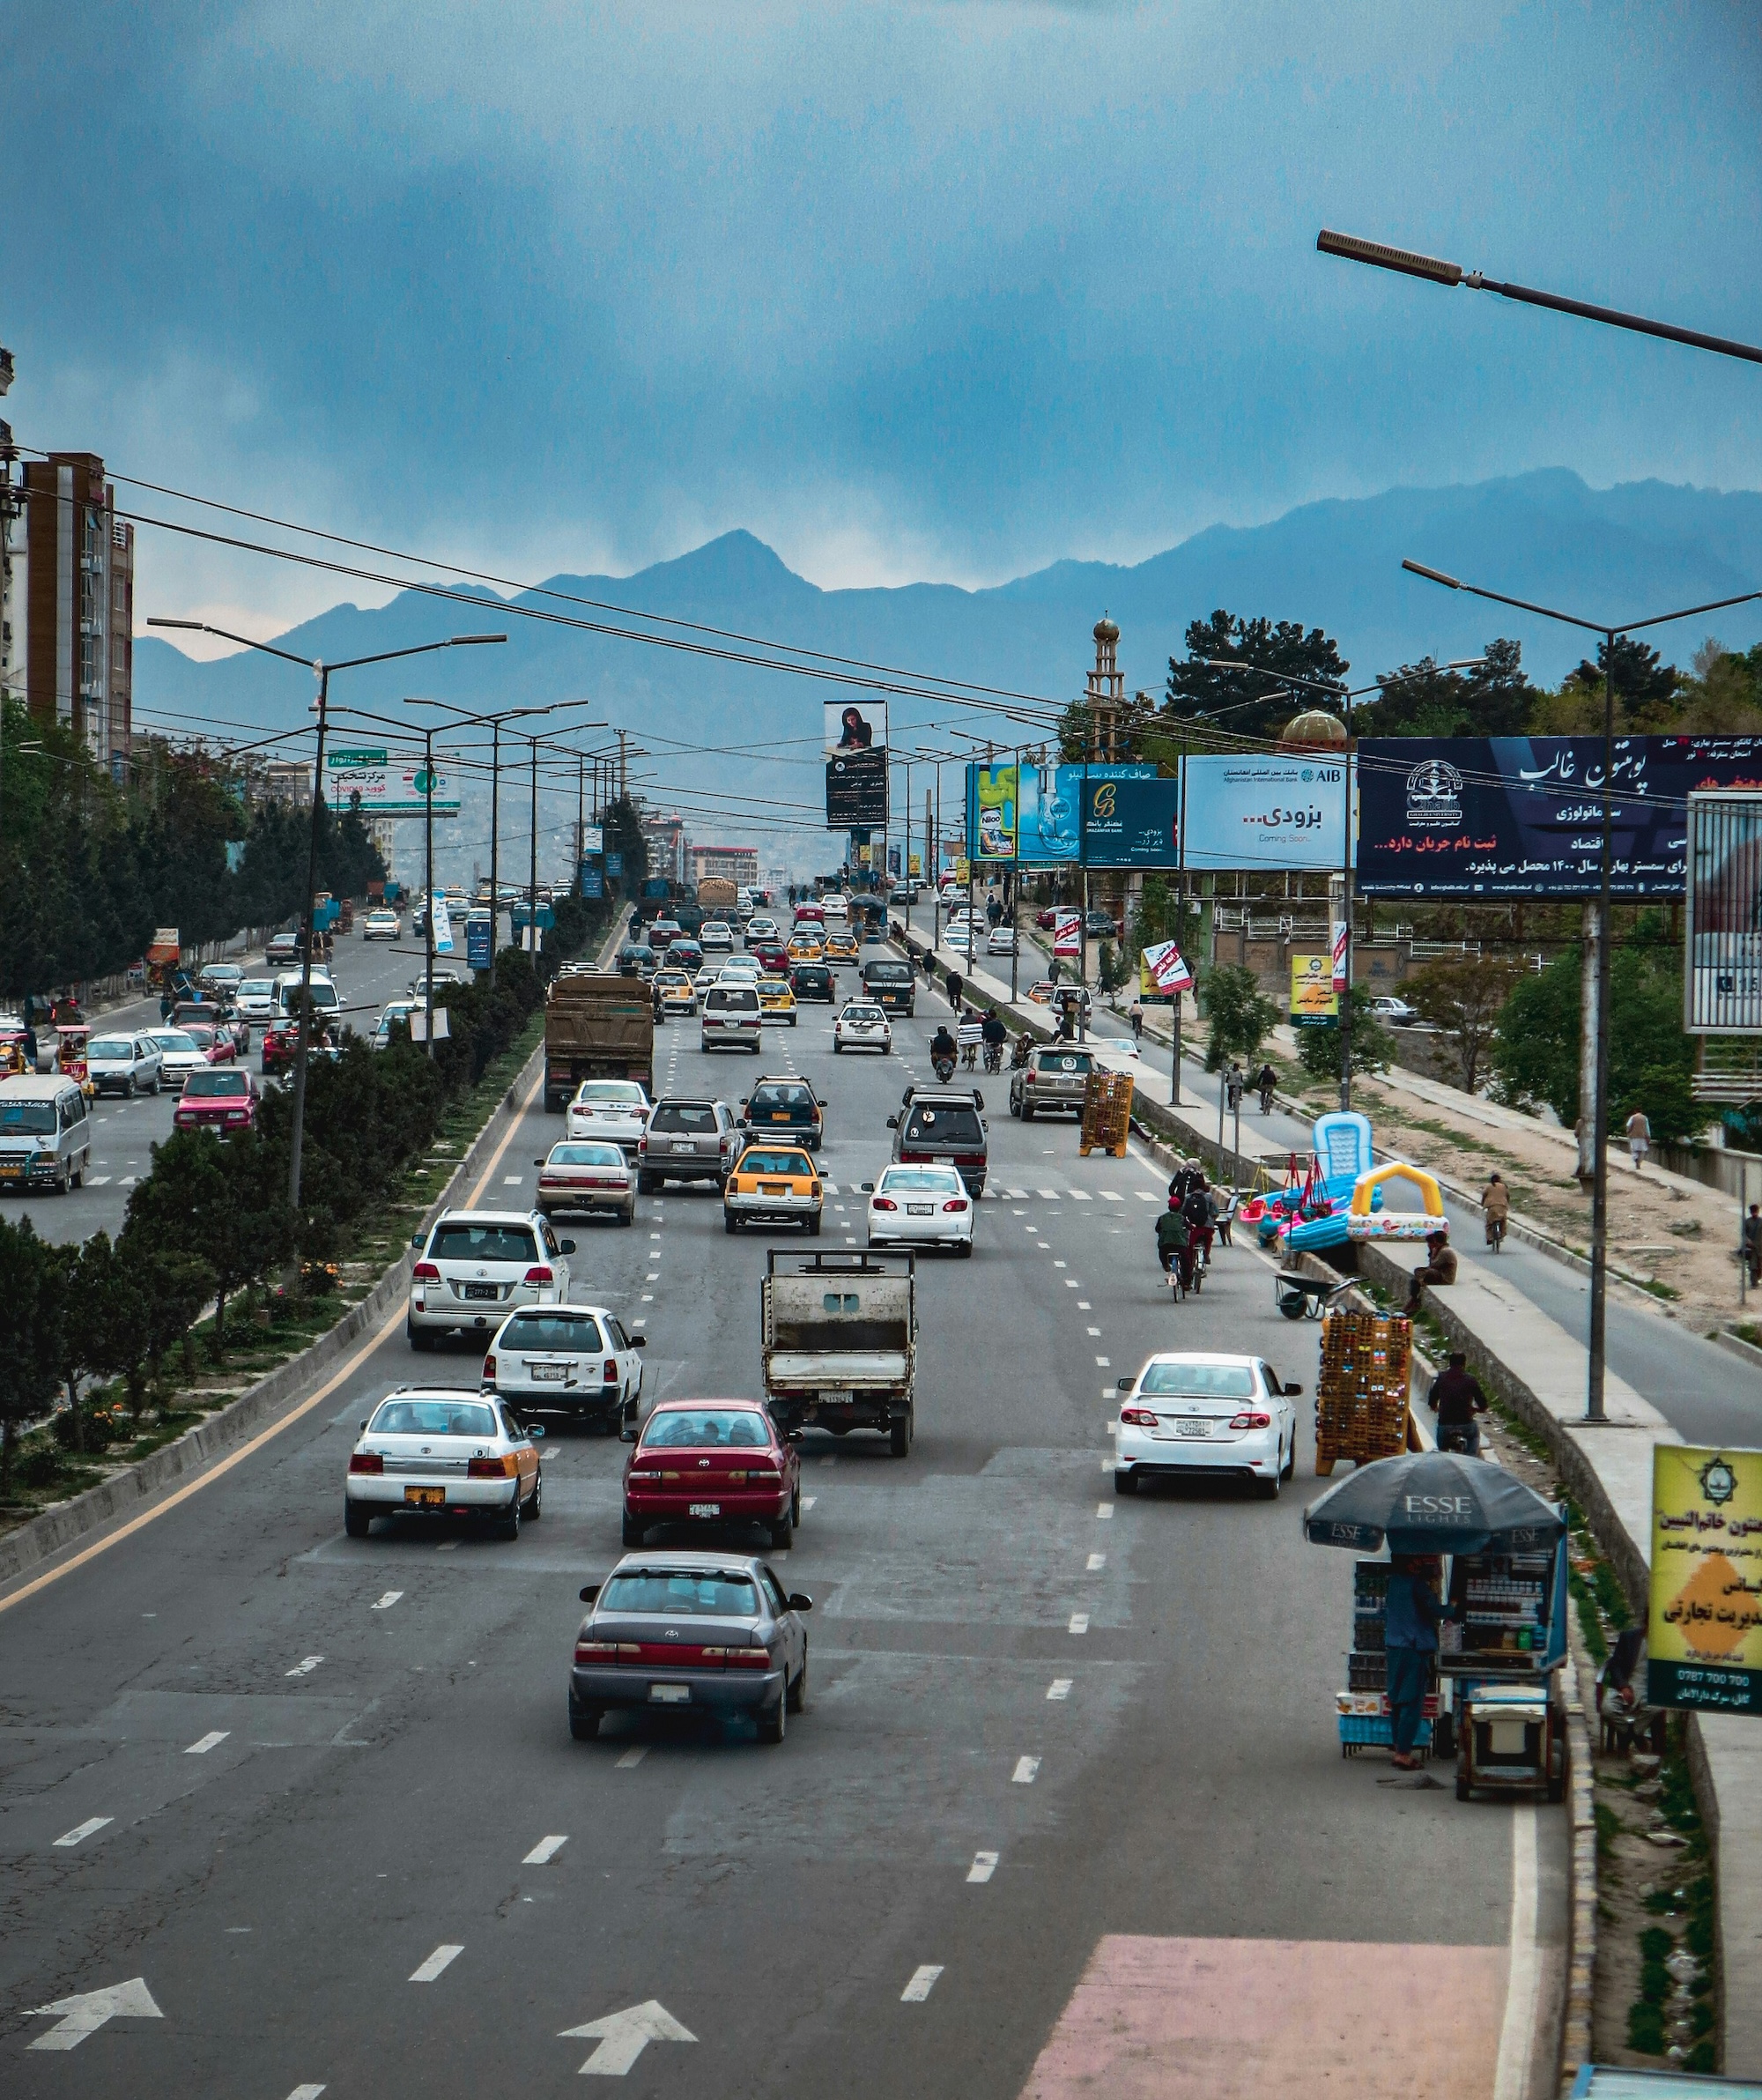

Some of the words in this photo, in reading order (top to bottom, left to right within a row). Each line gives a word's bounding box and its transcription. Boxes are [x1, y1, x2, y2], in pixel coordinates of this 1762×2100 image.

[1316, 770, 1341, 783] AIB
[1520, 750, 1576, 790] غالب
[1415, 836, 1452, 852] جریان
[1454, 835, 1471, 851] نام
[1473, 834, 1498, 851] ثبت
[1571, 836, 1604, 850] اقتصاد
[1499, 863, 1515, 874] می
[1518, 859, 1551, 874] محصل
[1577, 860, 1598, 874] سال
[1600, 859, 1630, 874] بهار
[1632, 860, 1665, 874] سمستر
[1667, 859, 1687, 874] رای
[1405, 1495, 1473, 1514] ESSE
[1408, 1514, 1471, 1525] LIGHTS
[1331, 1523, 1362, 1540] ESSE
[1512, 1528, 1540, 1544] ESSE
[1677, 1669, 1704, 1681] 0787
[1706, 1672, 1727, 1684] 700
[1729, 1674, 1750, 1687] 700
